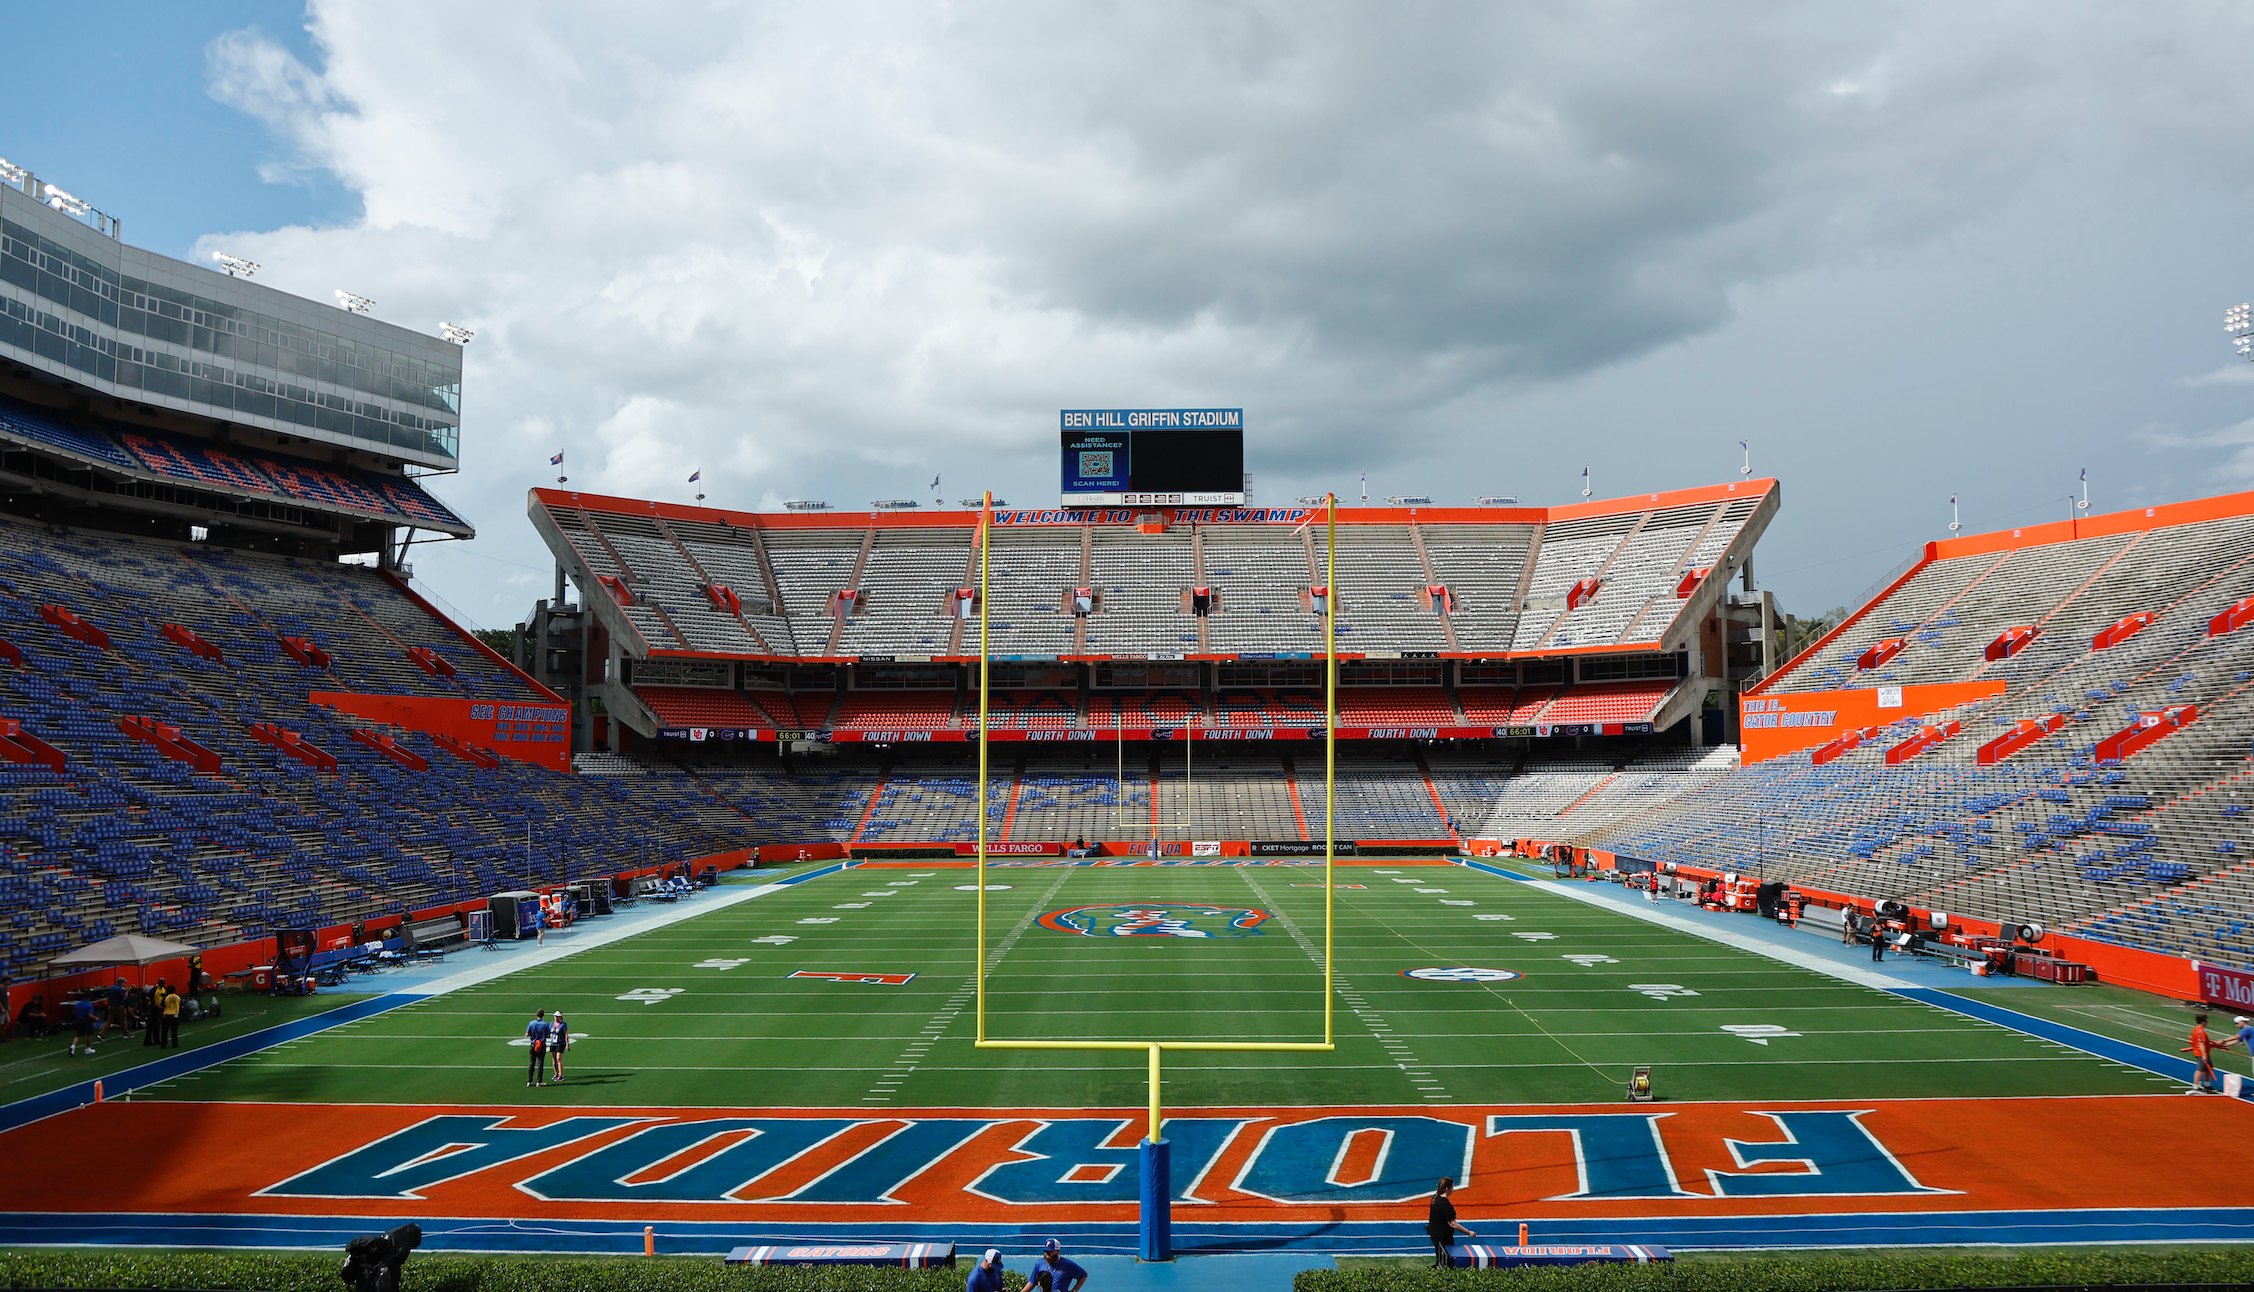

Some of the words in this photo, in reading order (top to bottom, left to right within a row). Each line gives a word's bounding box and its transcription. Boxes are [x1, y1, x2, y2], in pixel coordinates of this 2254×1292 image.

[1064, 412, 1092, 427] BEN
[1096, 412, 1125, 427] HILL
[1128, 412, 1180, 427] GRIFFIN
[1183, 411, 1239, 426] STADIUM
[994, 510, 1100, 524] WELCOME
[1103, 509, 1131, 522] TO
[1175, 509, 1213, 522] THE
[1215, 509, 1305, 523] SWAMP
[1743, 700, 1766, 713] THIS
[470, 704, 494, 720] SEC
[497, 705, 568, 722] CHAMPIONS
[1744, 713, 1778, 729] GATOR
[1781, 711, 1837, 728] COUNTRY
[709, 730, 714, 738] 0
[738, 730, 744, 738] 0
[1203, 729, 1242, 739] FOURTH
[1245, 729, 1274, 739] DOWN
[1368, 728, 1405, 739] FOURTH
[1409, 728, 1438, 738] DOWN
[1497, 728, 1506, 737] 40
[1509, 728, 1531, 736] 66:01
[1583, 725, 1589, 733] 0
[779, 732, 801, 740] 66:01
[806, 731, 815, 740] 40
[862, 731, 900, 741] FOURTH
[903, 731, 932, 741] DOWN
[1025, 730, 1064, 740] FOURTH
[1067, 730, 1096, 740] DOWN
[971, 844, 1007, 853] WELLS
[1008, 844, 1043, 853] FARGO
[1128, 843, 1182, 856] FLOIDA
[1194, 843, 1219, 851] ESPN
[255, 973, 266, 985] G
[252, 1113, 1968, 1204] FLORIDA
[786, 1246, 892, 1258] GATORS
[1502, 1246, 1613, 1256] FLORIDA
